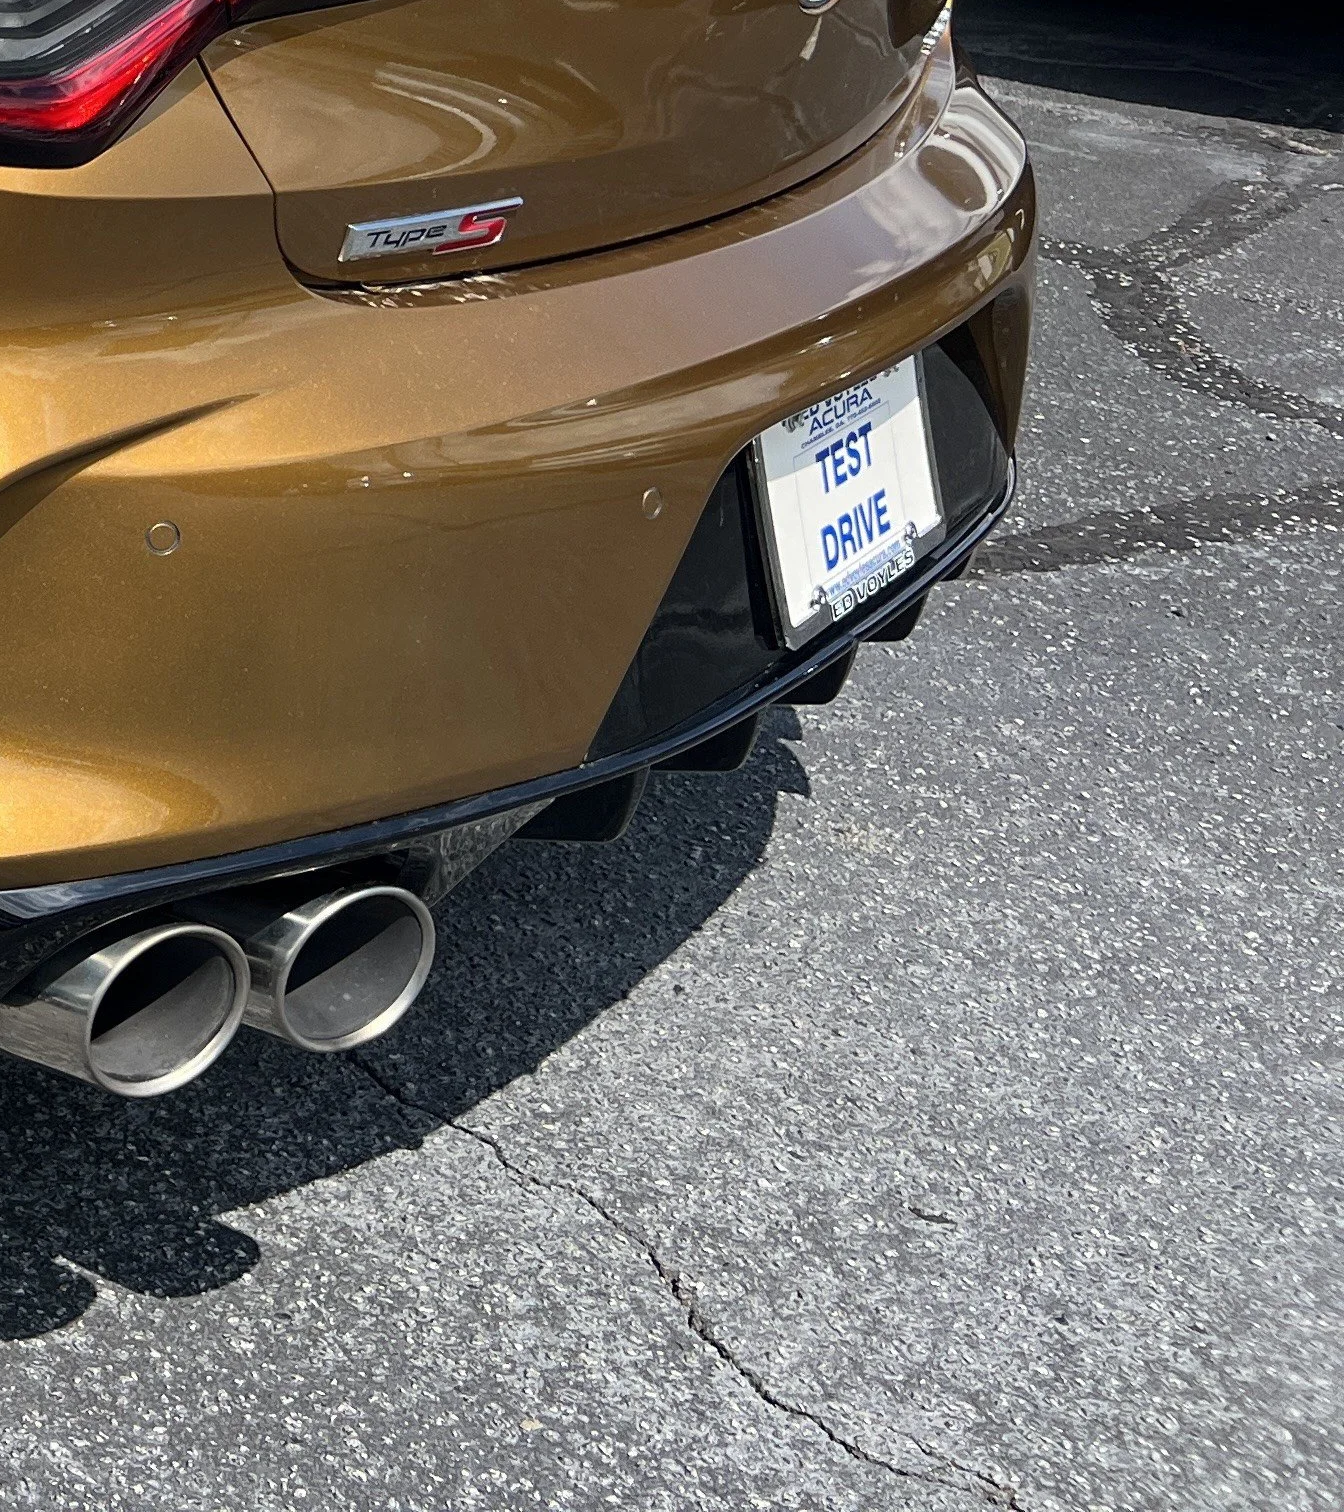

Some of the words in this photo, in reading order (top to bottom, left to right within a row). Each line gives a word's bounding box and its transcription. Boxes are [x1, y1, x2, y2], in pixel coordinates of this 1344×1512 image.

[808, 387, 873, 436] ACURA
[815, 421, 873, 495] TEST
[820, 489, 892, 572] DRIVE
[832, 589, 854, 621] ED
[855, 548, 915, 604] VOYLES
